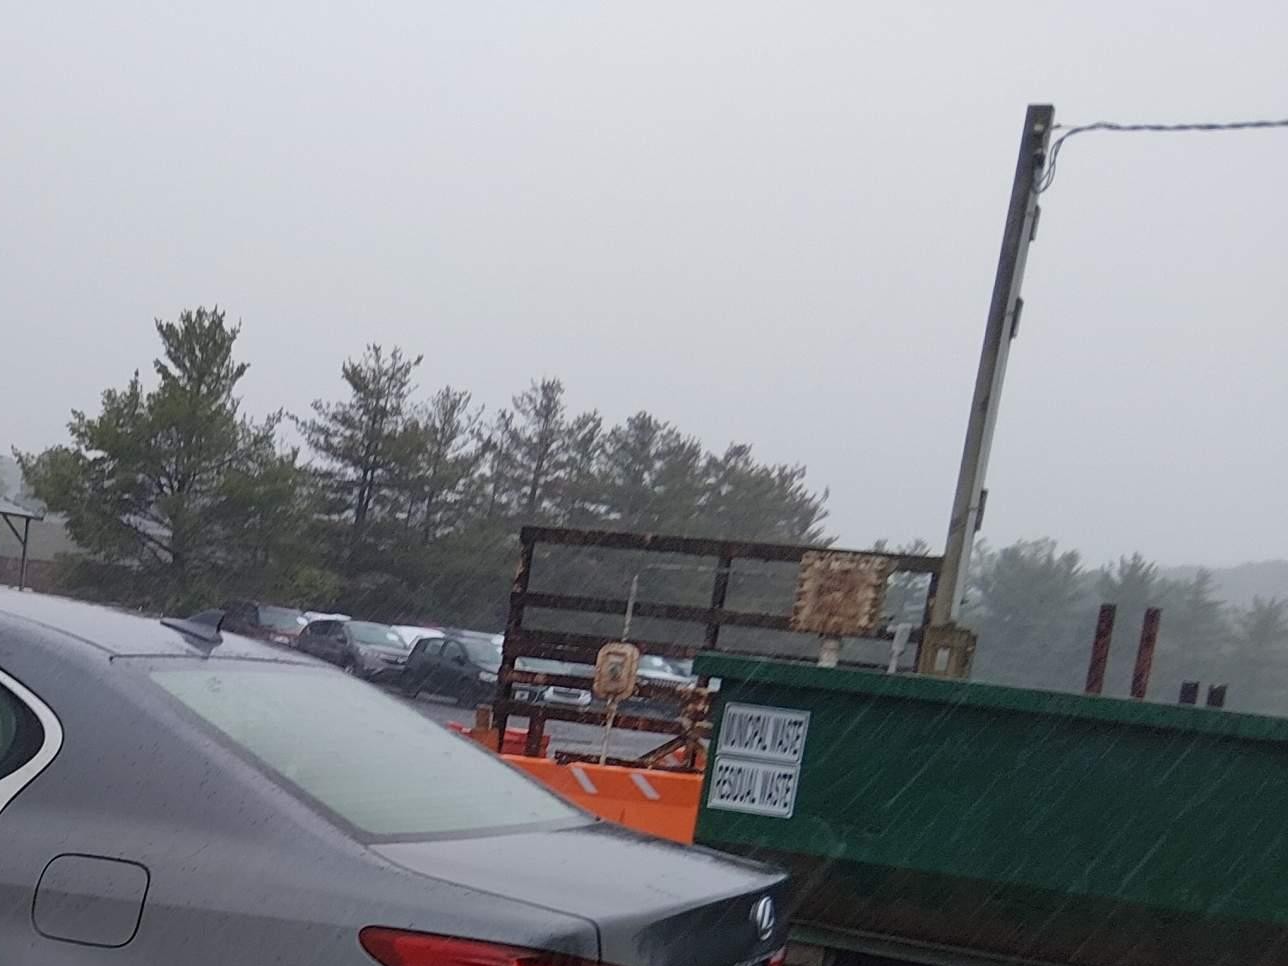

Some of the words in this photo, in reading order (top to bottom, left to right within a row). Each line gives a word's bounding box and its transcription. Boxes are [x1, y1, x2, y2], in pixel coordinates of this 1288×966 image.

[770, 717, 803, 756] WASTE
[715, 764, 759, 804] RESIDUAL
[759, 769, 793, 809] WASTE
